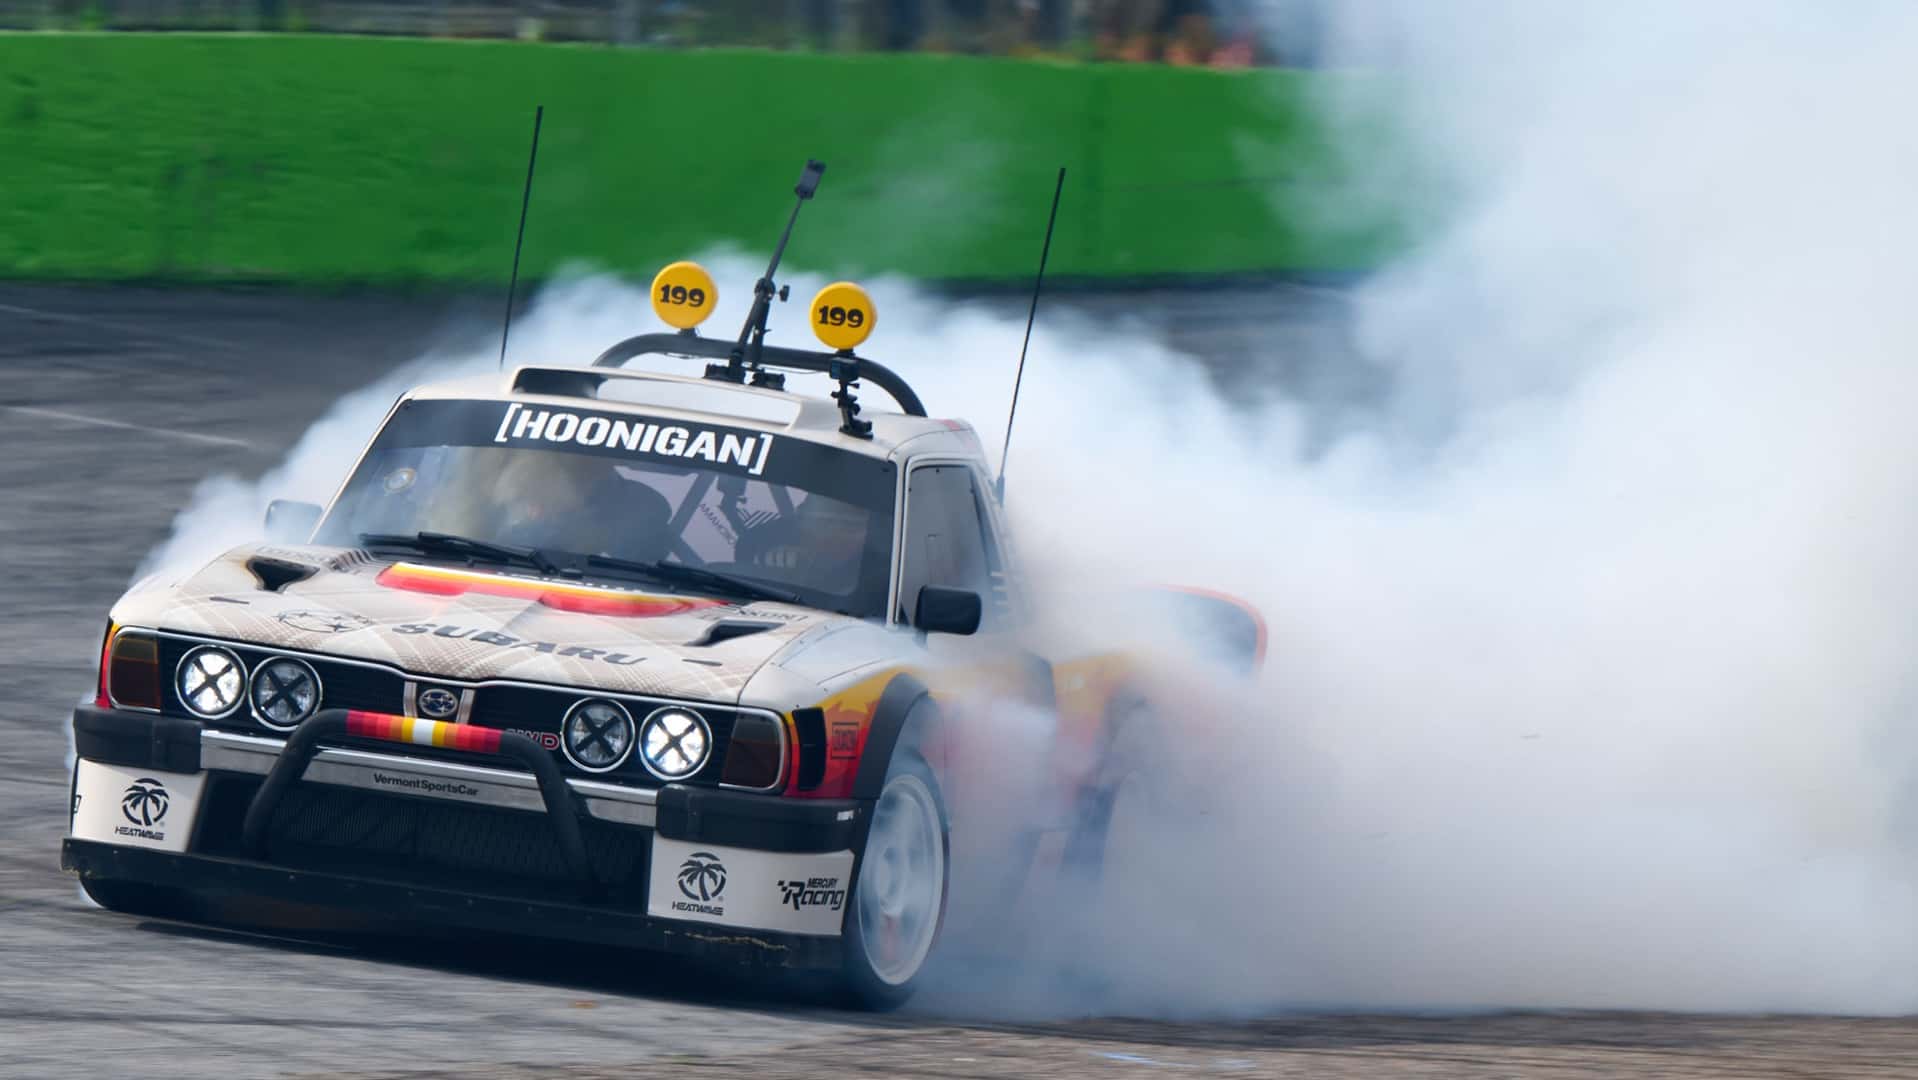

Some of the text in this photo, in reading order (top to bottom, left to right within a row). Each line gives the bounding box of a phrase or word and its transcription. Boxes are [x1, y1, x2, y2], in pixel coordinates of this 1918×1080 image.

[660, 284, 705, 307] 199
[818, 305, 864, 328] 199
[495, 402, 774, 475] [HOONIGAN]
[391, 623, 648, 665] SUBARU
[373, 773, 479, 796] VermontSportsCar
[782, 880, 845, 911] Racing
[671, 901, 724, 916] HEATWAVE
